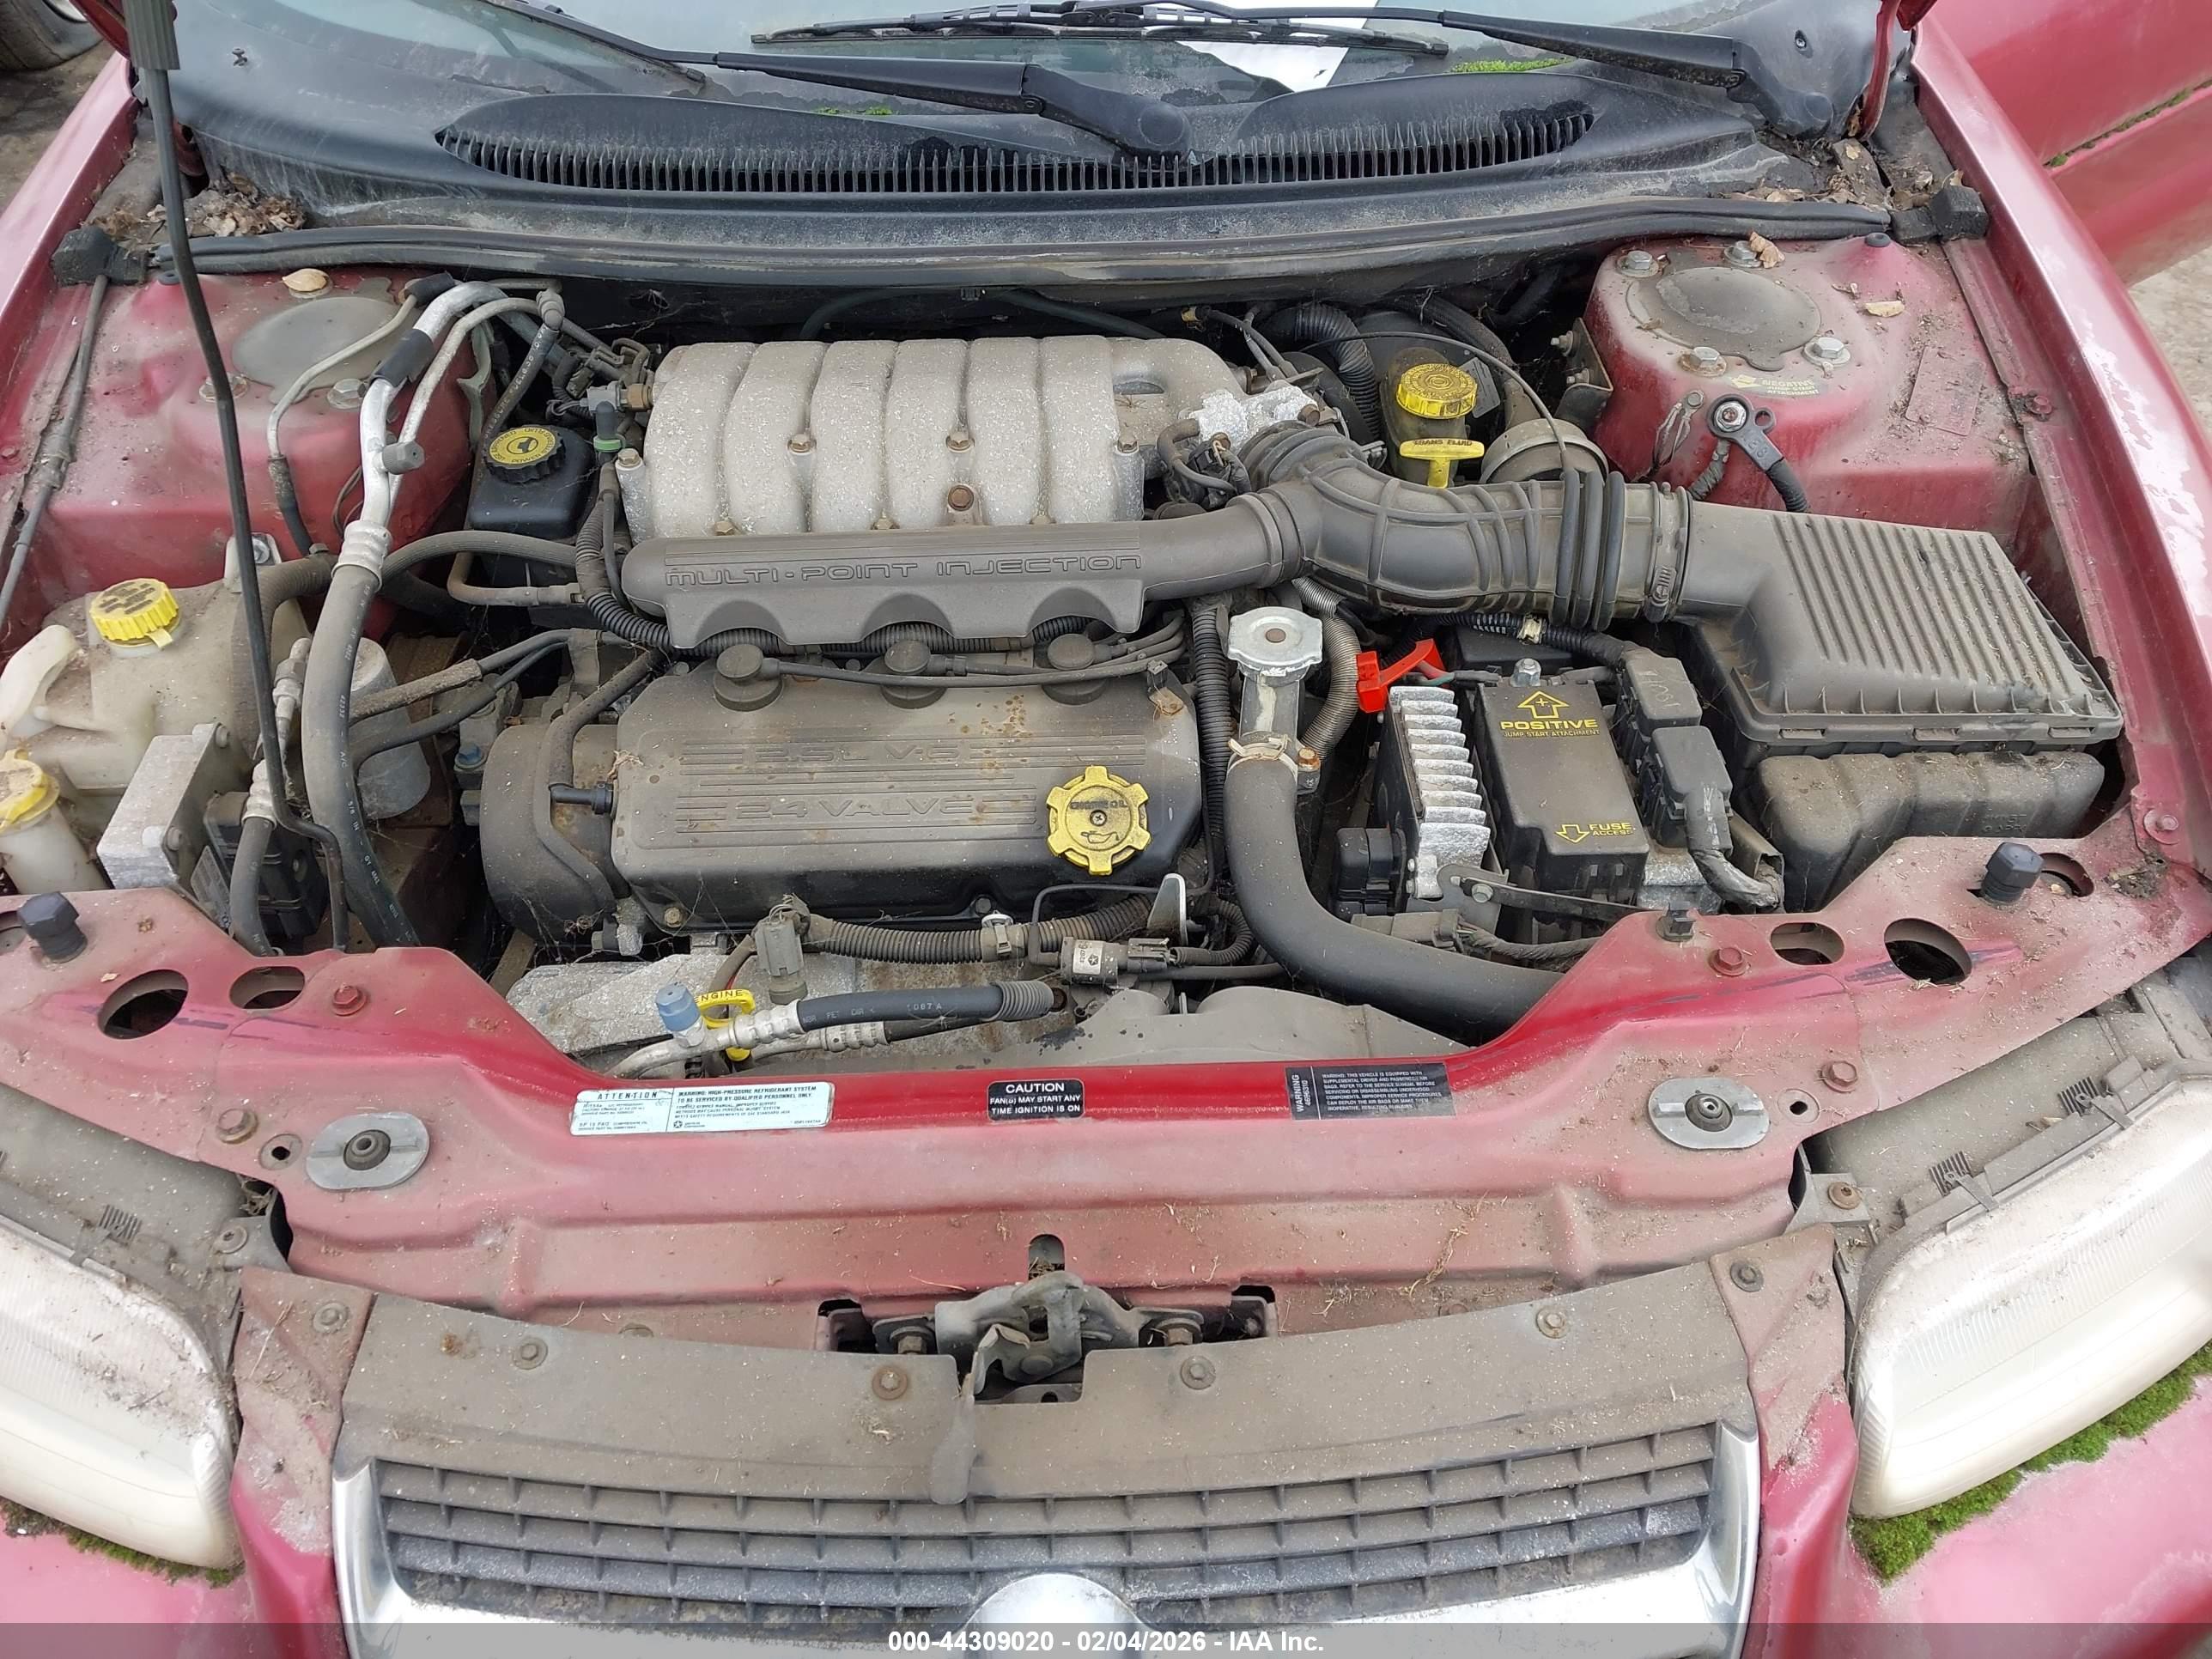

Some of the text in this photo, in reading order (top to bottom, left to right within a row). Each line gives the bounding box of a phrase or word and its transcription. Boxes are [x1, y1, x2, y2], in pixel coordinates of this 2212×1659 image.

[937, 556, 1140, 575] INJECTION
[1500, 720, 1598, 730] POSITIVE
[736, 797, 974, 819] 24 VALVE
[1589, 822, 1632, 831] FUSE
[1006, 1082, 1065, 1093] CAUTION
[1291, 1074, 1304, 1112] WARNING
[598, 1091, 658, 1100] ATTENTION
[1015, 1105, 1054, 1114] IGNITION
[1067, 1103, 1080, 1112] ON
